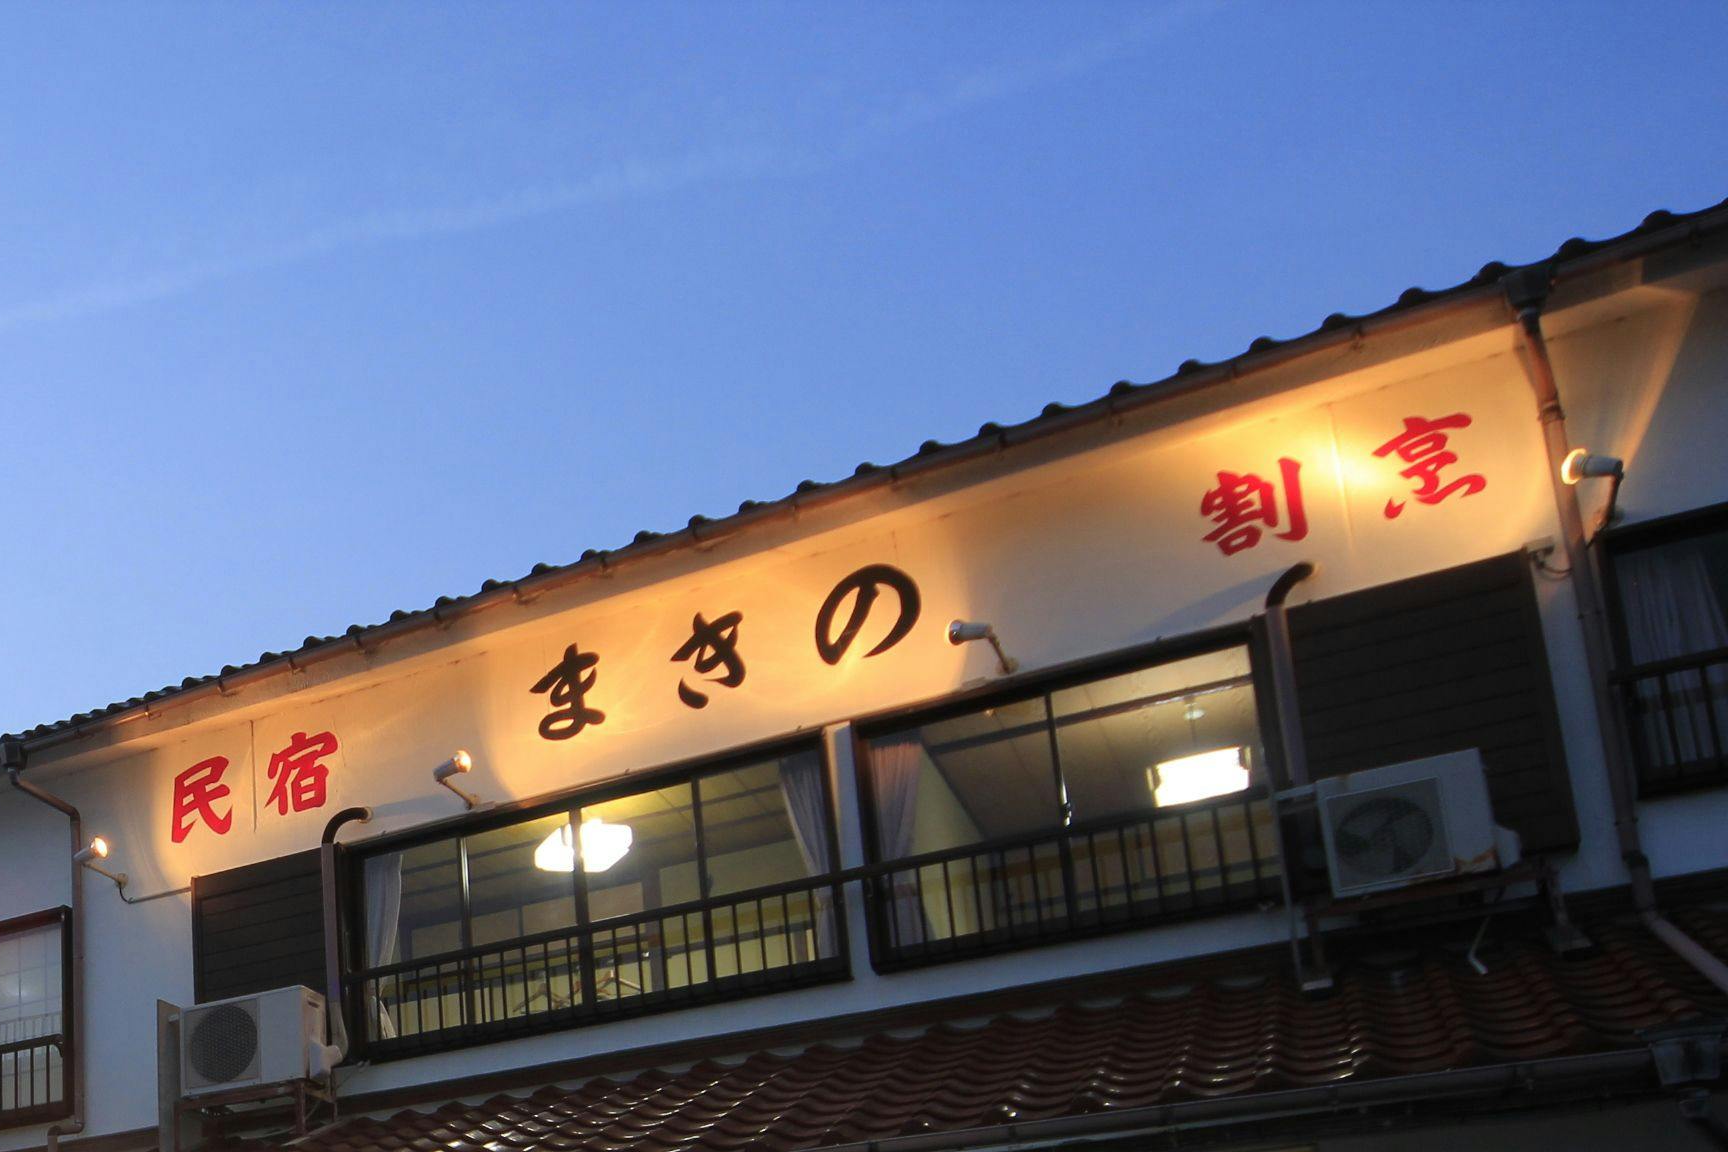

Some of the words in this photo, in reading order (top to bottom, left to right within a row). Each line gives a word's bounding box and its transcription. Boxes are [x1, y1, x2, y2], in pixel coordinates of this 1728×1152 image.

[170, 731, 339, 845] 民宿
[529, 562, 922, 741] まきの
[1199, 412, 1488, 556] 割烹
